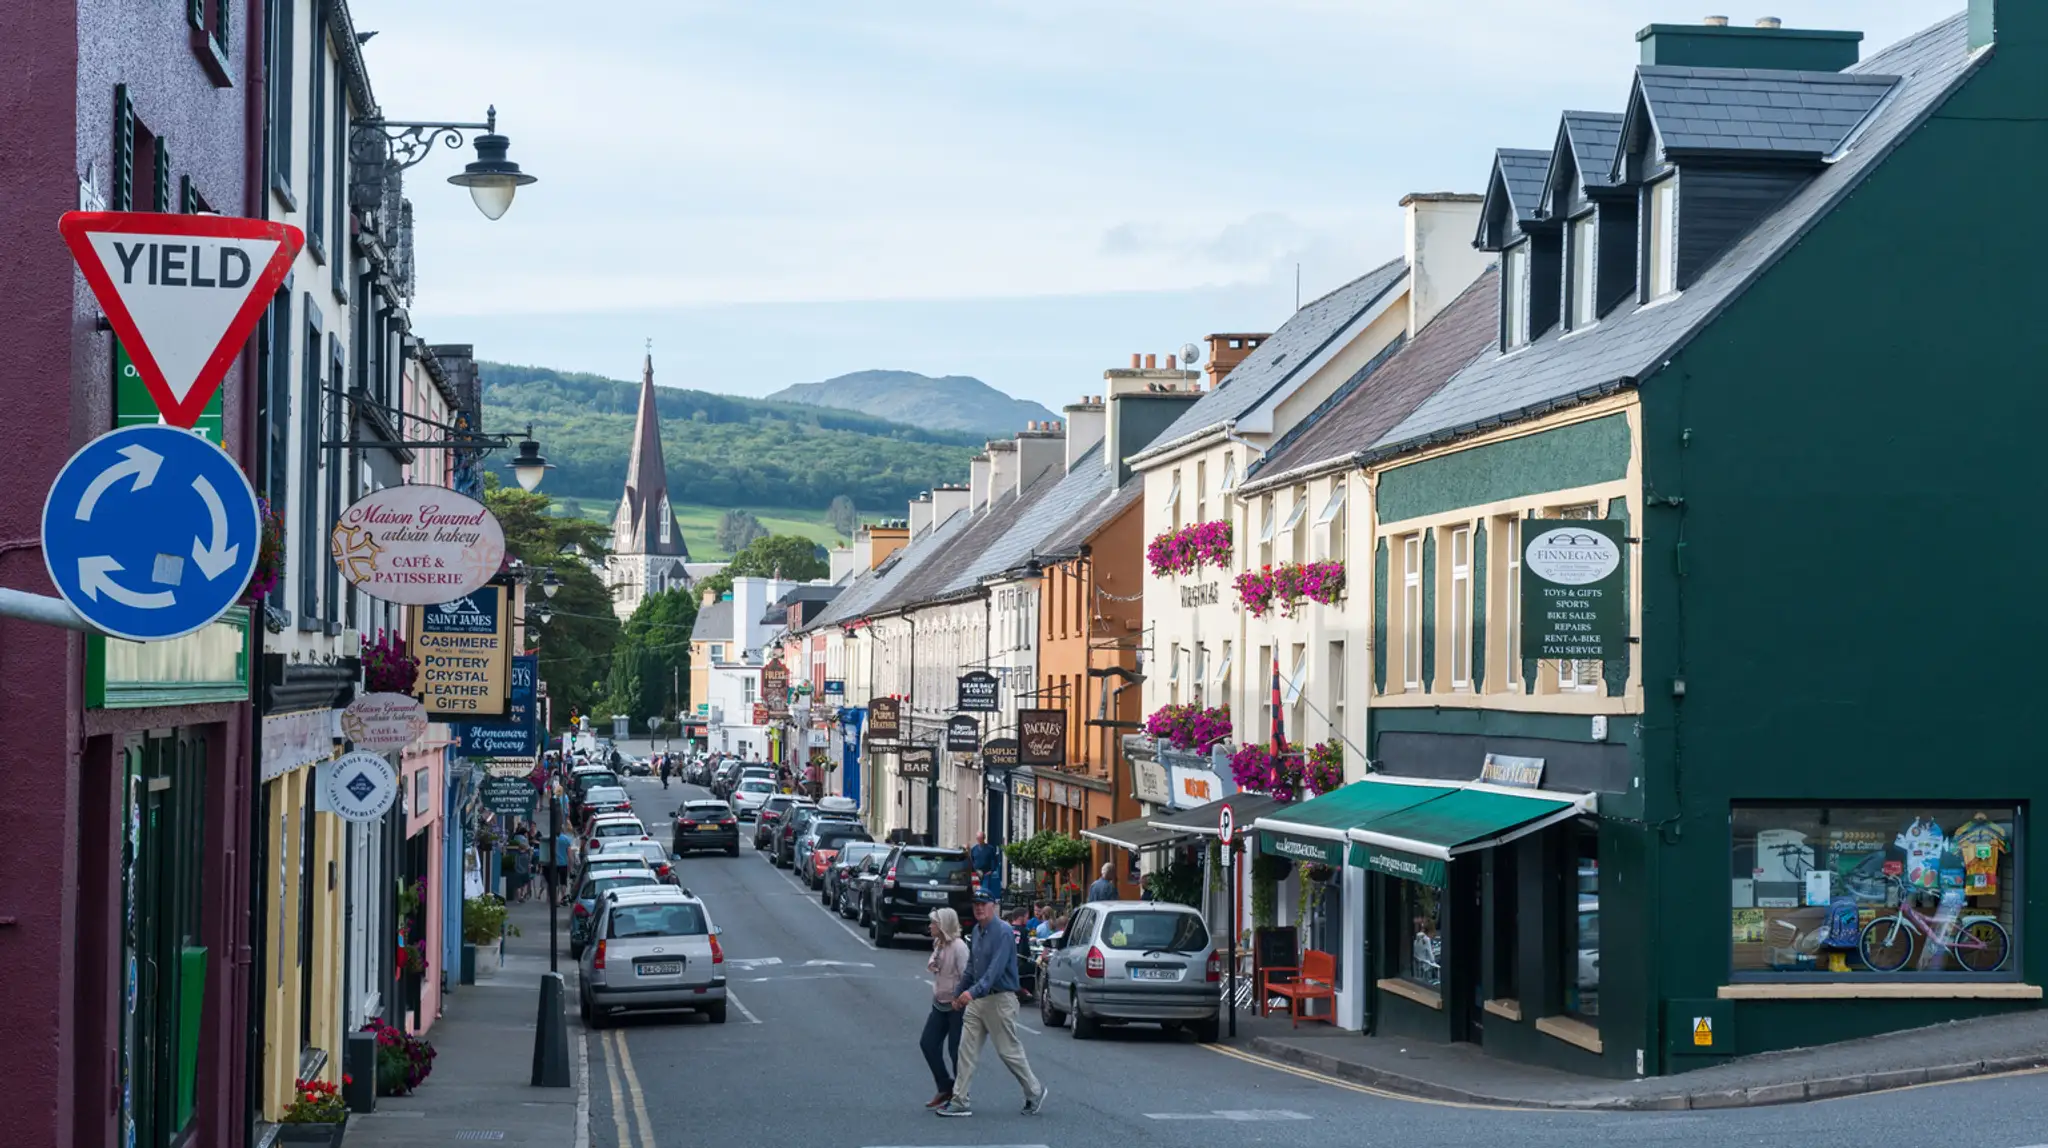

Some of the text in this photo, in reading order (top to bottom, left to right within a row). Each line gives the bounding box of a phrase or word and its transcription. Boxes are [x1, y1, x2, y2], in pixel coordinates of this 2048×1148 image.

[113, 242, 251, 288] YIELD
[350, 504, 486, 529] Maison Gourmet
[381, 526, 481, 548] artisan bakery
[392, 554, 445, 568] CAFÉ &
[1537, 550, 1609, 560] FINNEGANS
[374, 572, 463, 584] PATISSERIE
[1577, 589, 1602, 597] GIFTS
[427, 613, 492, 626] SAINT JAMES
[1554, 623, 1591, 631] REPAIRS
[420, 635, 498, 648] CASHMERE
[1565, 646, 1602, 654] SERVICE
[425, 655, 489, 668] POTTERY
[425, 669, 489, 682] CRYSTAL
[425, 683, 488, 695] LEATHER
[436, 697, 477, 709] GIFTS
[470, 726, 528, 738] Homeware
[1024, 722, 1061, 736] PACKIE'S
[471, 738, 525, 751] & Grocery
[984, 748, 1017, 756] SIMPLICI
[903, 763, 929, 772] BAR
